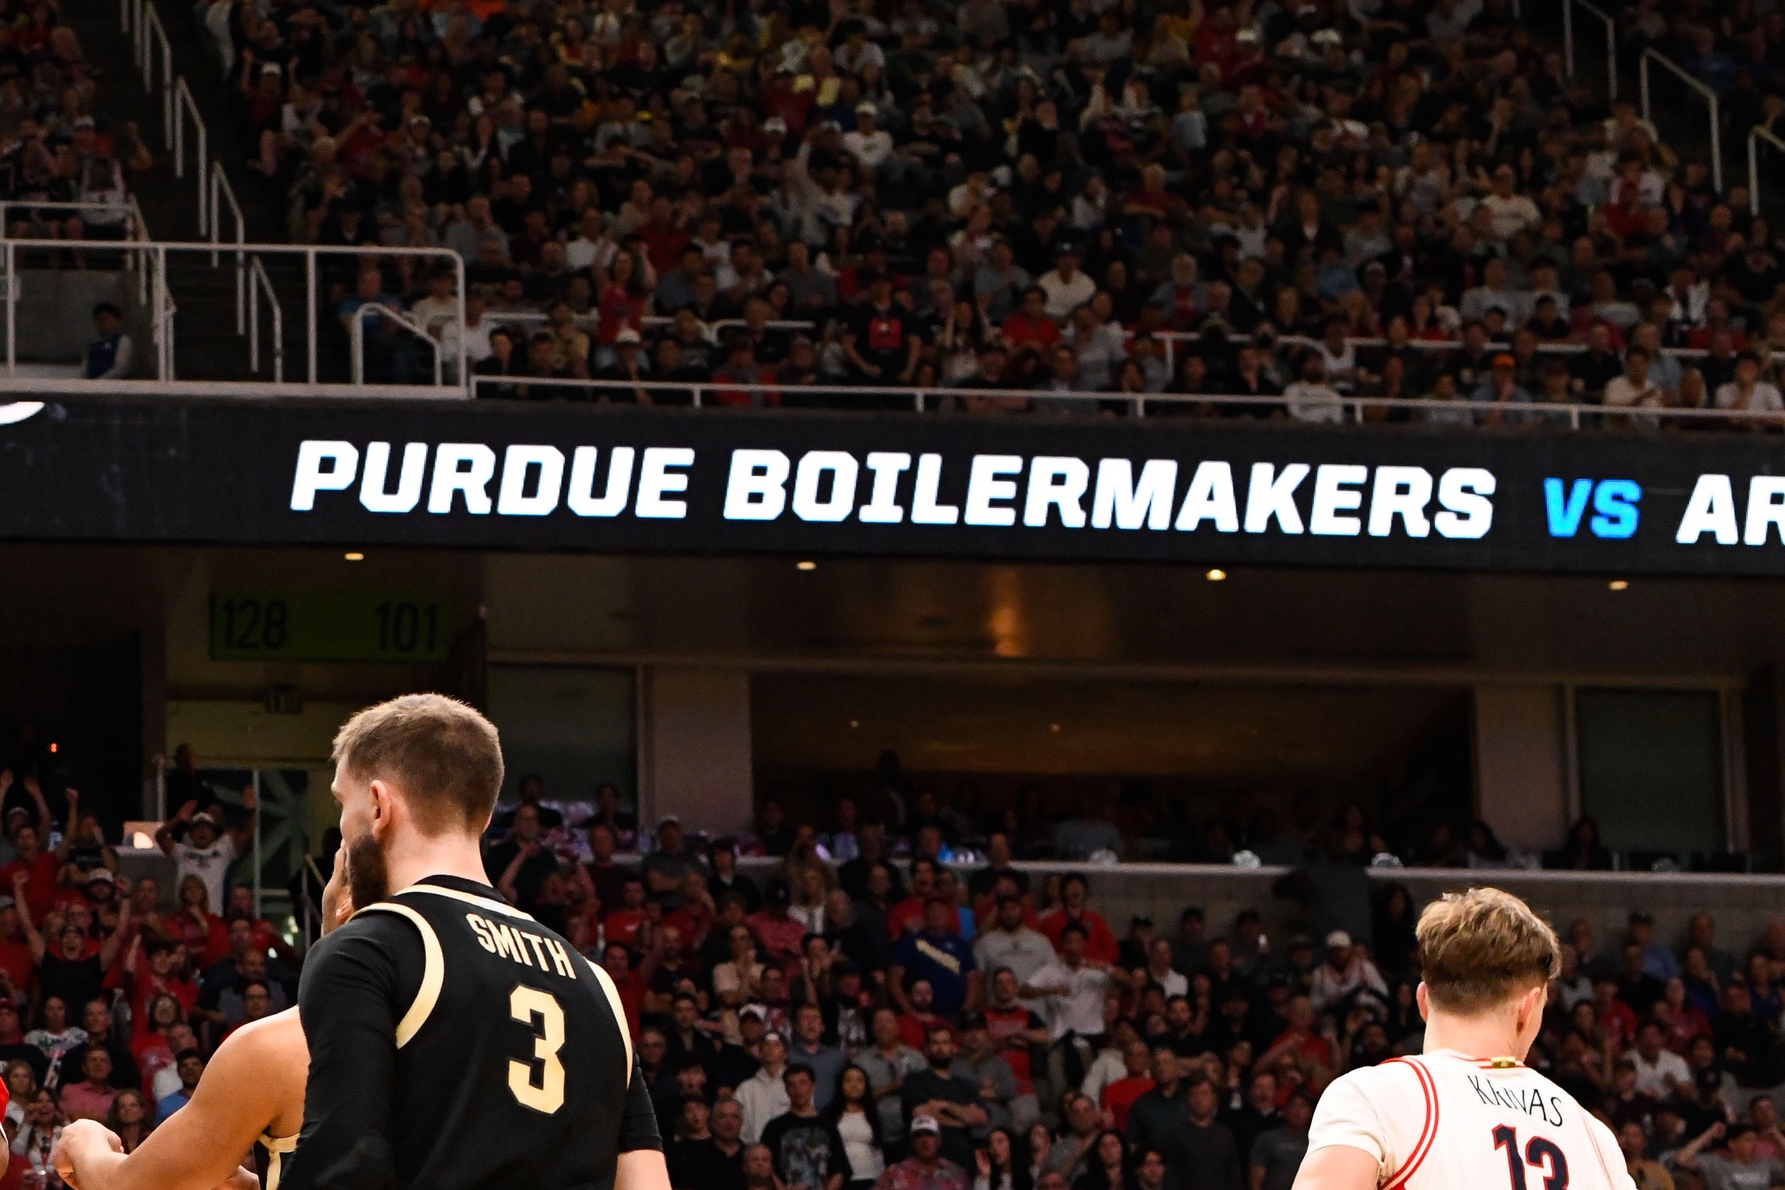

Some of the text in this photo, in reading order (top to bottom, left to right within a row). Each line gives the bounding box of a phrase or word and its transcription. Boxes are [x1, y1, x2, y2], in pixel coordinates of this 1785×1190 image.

[291, 440, 696, 519] PURDUE
[724, 449, 1497, 539] BOILERMAKERS
[1544, 477, 1643, 540] VS
[221, 598, 288, 650] 128
[375, 601, 439, 653] 101
[465, 912, 577, 980] SMITH
[508, 984, 566, 1116] 3
